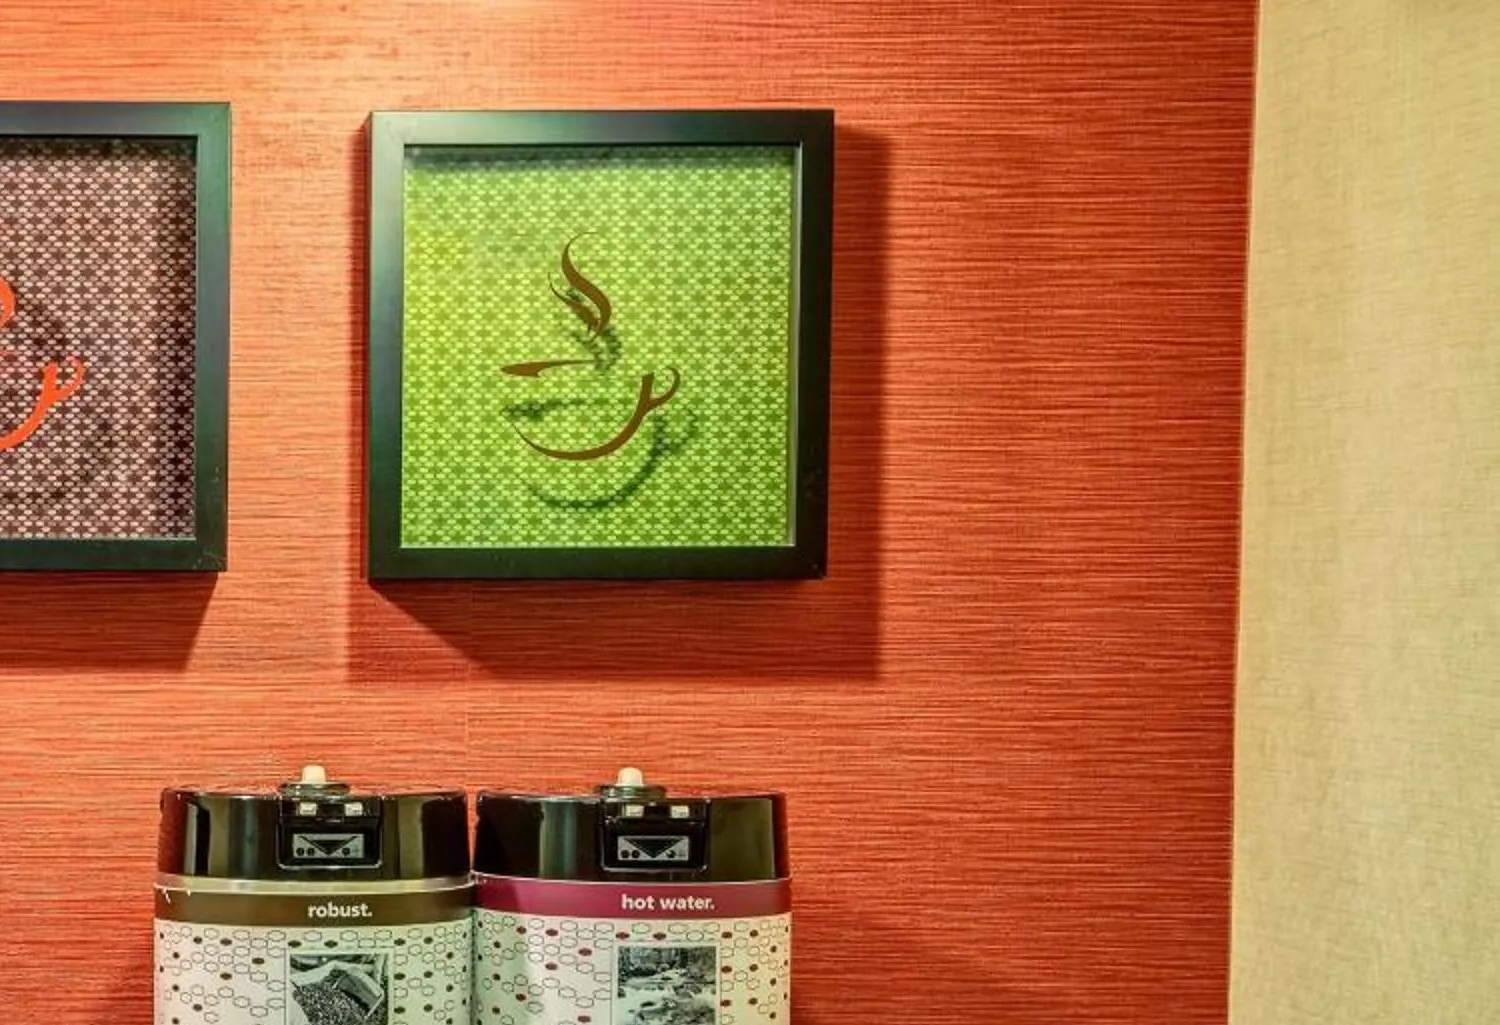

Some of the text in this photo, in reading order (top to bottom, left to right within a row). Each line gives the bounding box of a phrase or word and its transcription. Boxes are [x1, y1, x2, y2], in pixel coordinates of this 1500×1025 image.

[307, 901, 373, 918] robust.
[621, 893, 715, 910] hot water.
